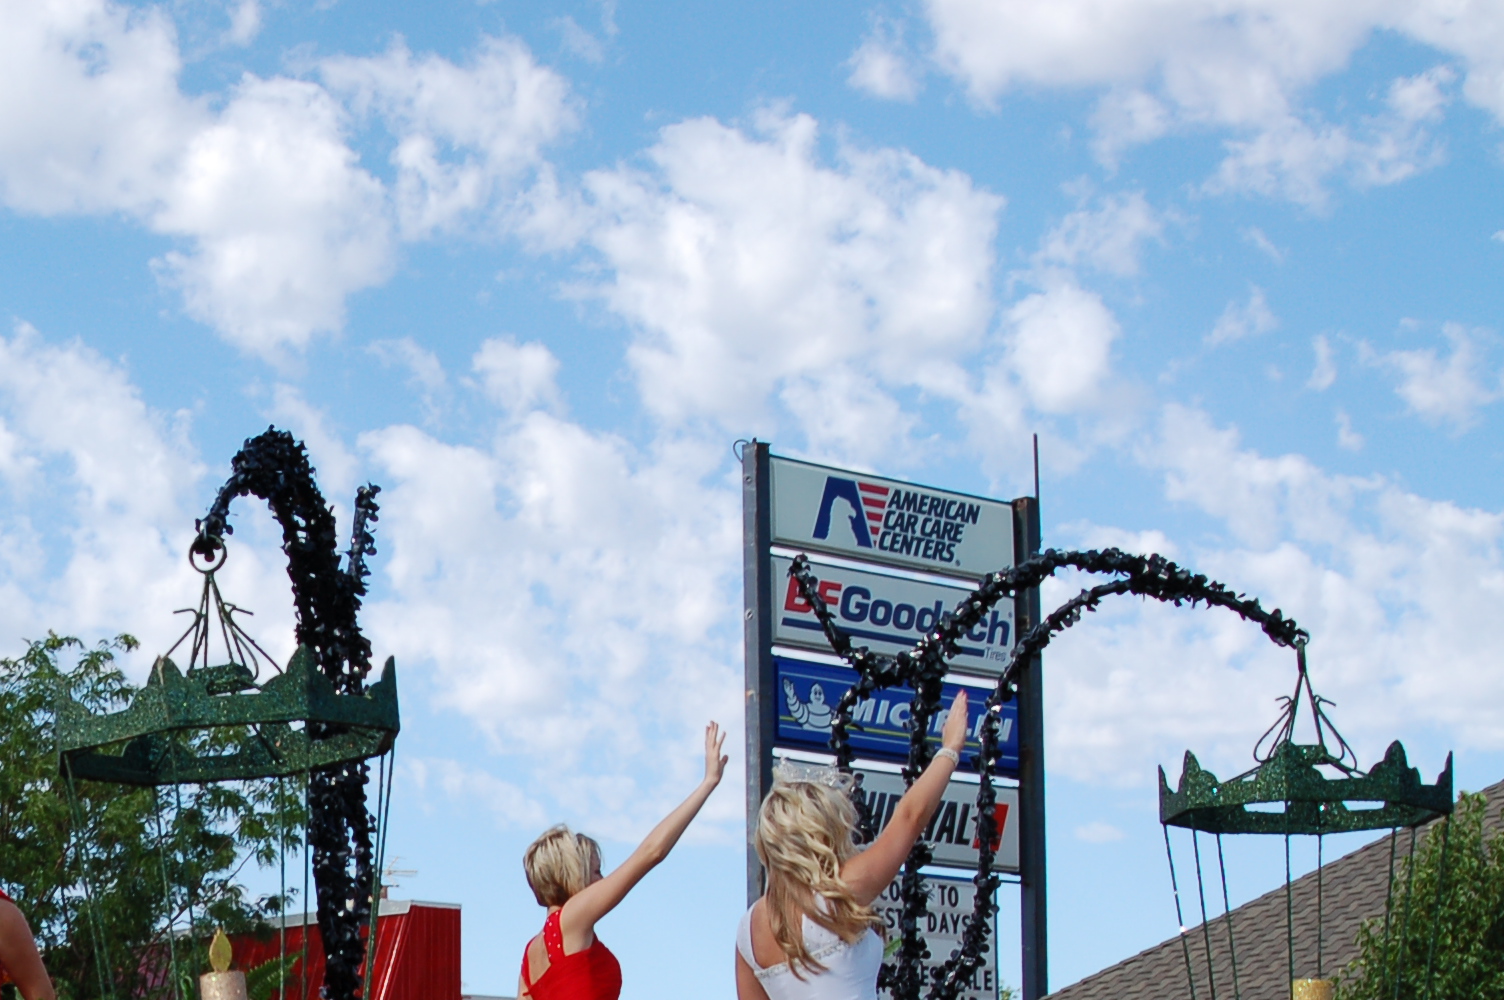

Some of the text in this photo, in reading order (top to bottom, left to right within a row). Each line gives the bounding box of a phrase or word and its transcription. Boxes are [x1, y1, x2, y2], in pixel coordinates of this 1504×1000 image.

[887, 489, 981, 525] AMERICAN
[883, 510, 965, 543] CAR CARE
[878, 530, 956, 563] CENTERS
[784, 576, 1011, 647] BFGoodch
[984, 647, 1006, 662] Tires
[938, 885, 959, 907] TO
[927, 912, 971, 934] DAYS
